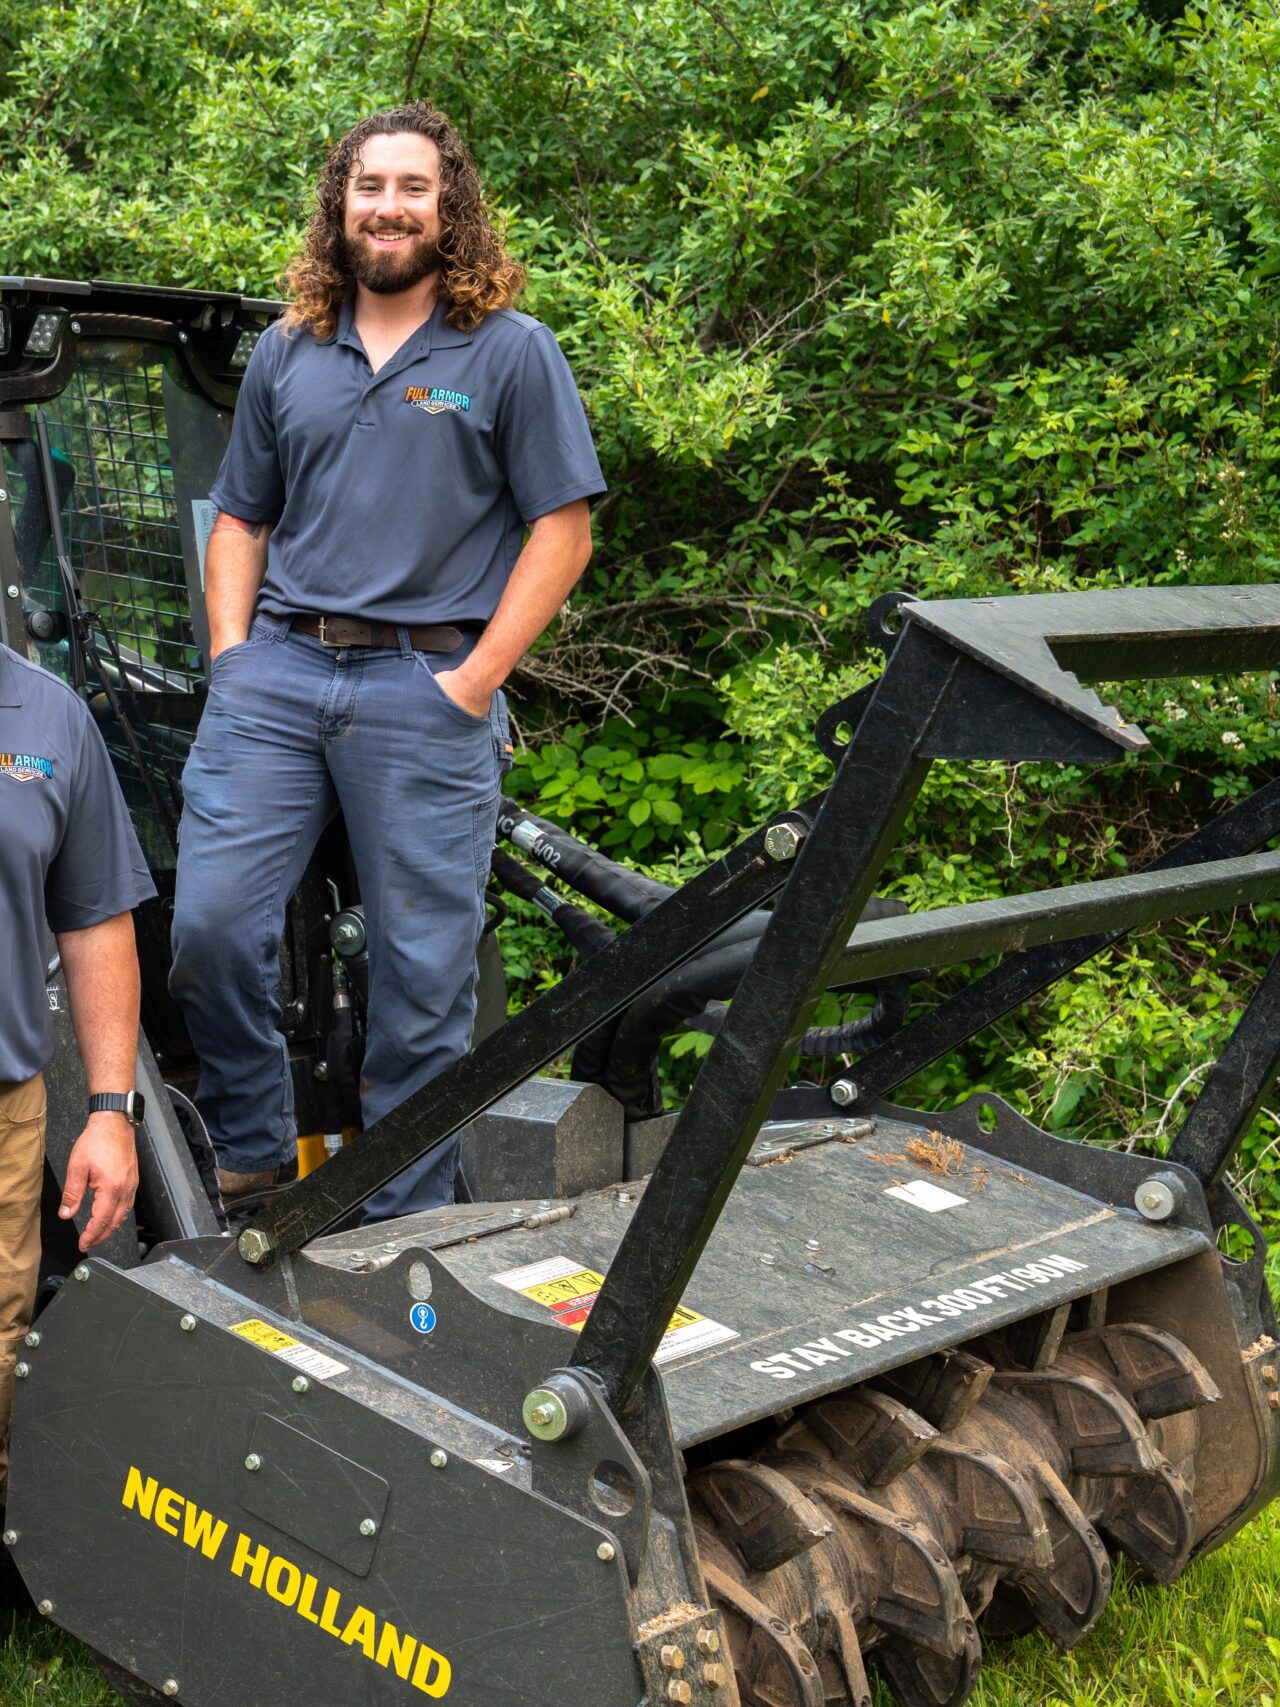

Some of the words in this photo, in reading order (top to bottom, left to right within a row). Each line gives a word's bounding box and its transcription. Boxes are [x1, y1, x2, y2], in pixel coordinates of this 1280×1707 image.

[405, 386, 429, 402] FULL
[430, 388, 471, 411] ARMOR
[14, 754, 53, 778] ARMOR
[749, 1337, 852, 1379] STAY
[834, 1305, 945, 1349] BACK
[122, 1466, 228, 1560] NEW
[230, 1532, 452, 1699] HOLLAND
